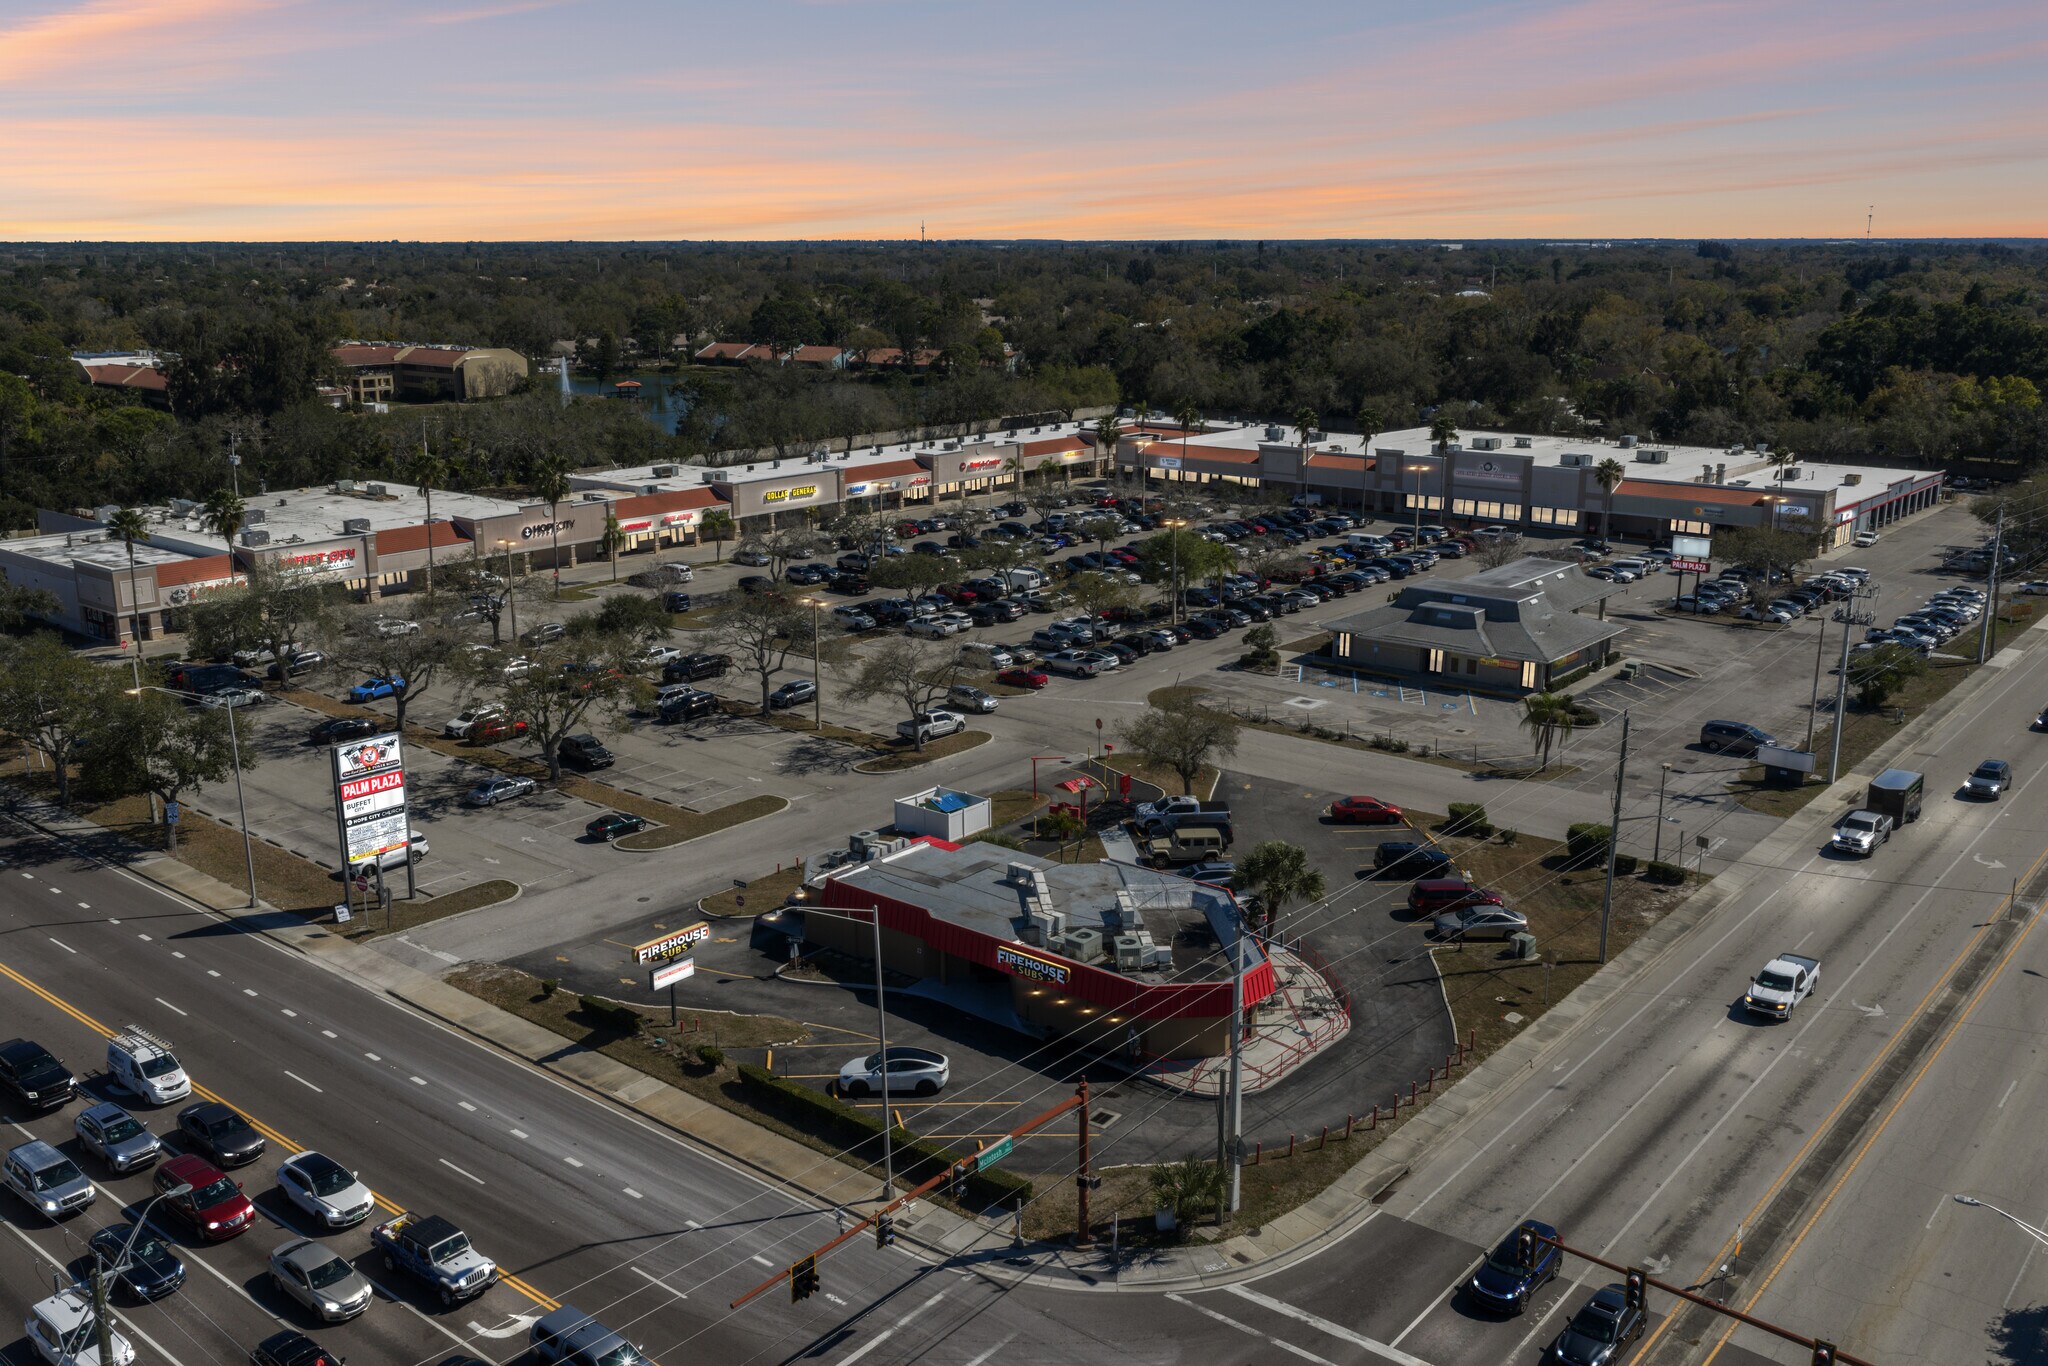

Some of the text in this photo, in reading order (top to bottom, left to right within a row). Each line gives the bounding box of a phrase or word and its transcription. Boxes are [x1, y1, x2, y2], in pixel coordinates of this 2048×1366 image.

[766, 485, 816, 500] DOLLAR GENERAL
[558, 519, 576, 531] CITY
[329, 548, 356, 562] CITY
[1672, 561, 1707, 572] PALM PLAZA
[343, 773, 401, 798] PALM PLAZA
[346, 799, 371, 810] BUFFET
[353, 816, 368, 824] HOPE
[381, 807, 403, 817] CHURCH
[639, 927, 709, 966] FIREHOUSE
[661, 943, 688, 959] SUBS
[997, 949, 1066, 984] FIREHOUSE
[1018, 965, 1044, 981] SUBS
